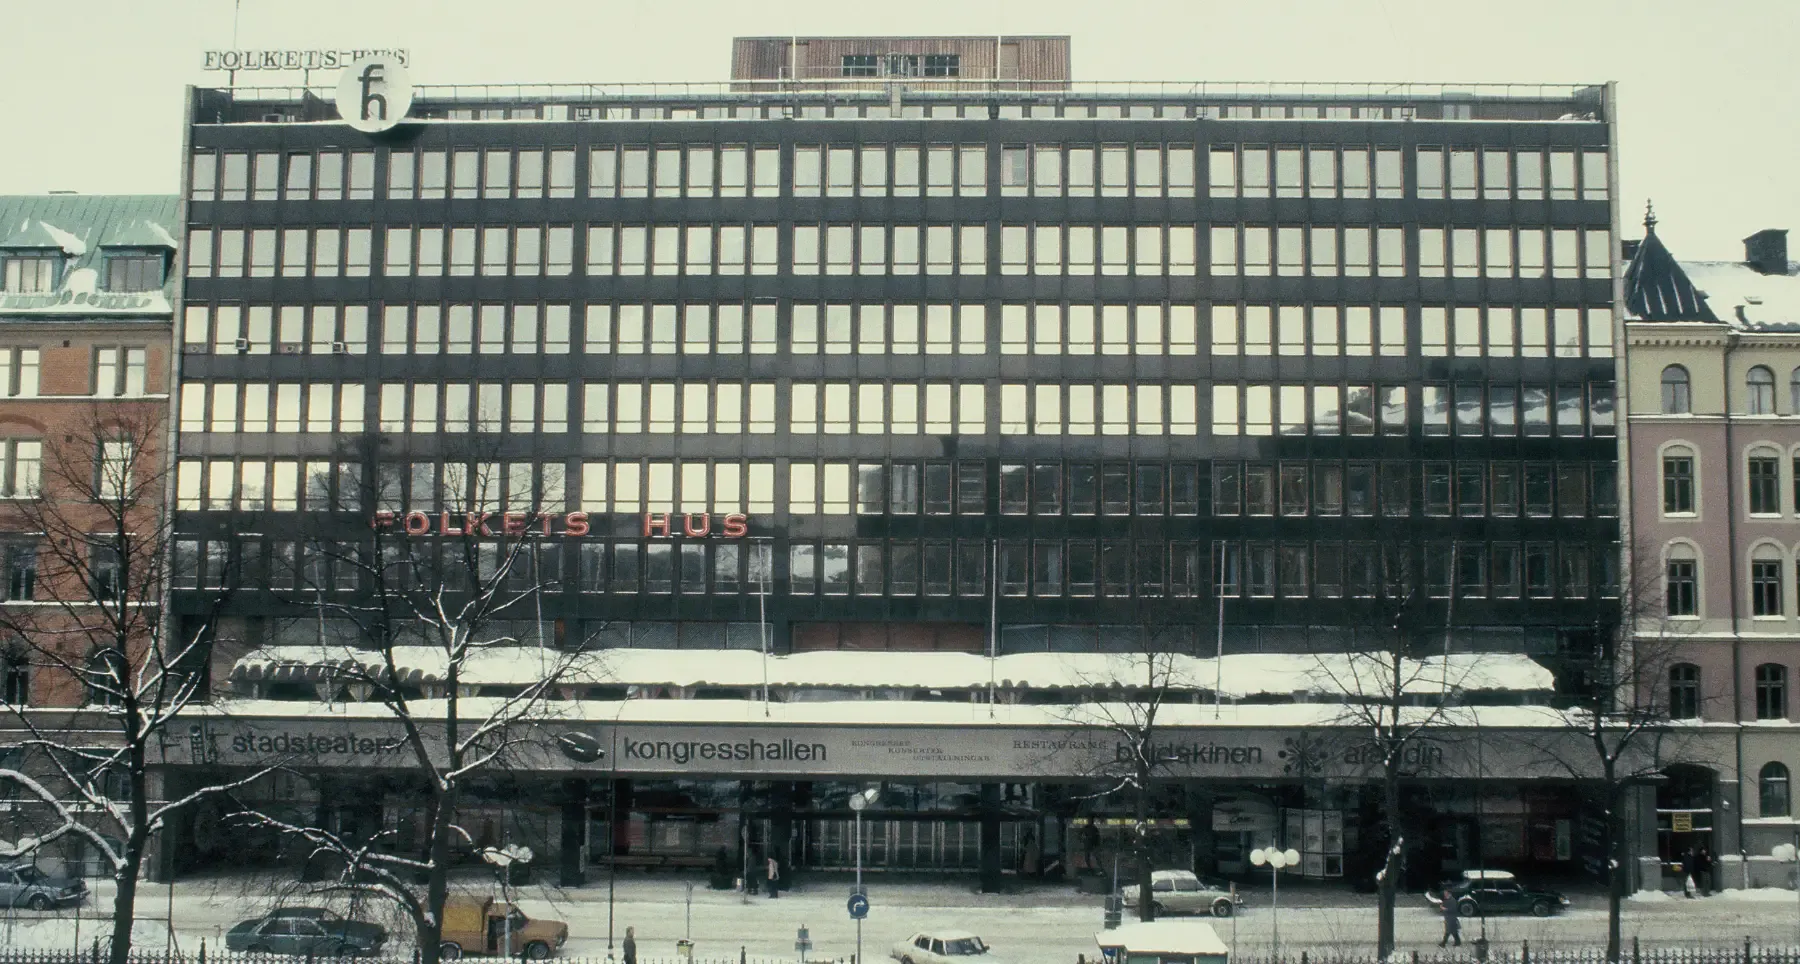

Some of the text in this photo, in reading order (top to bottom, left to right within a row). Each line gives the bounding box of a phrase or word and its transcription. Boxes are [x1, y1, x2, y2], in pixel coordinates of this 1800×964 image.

[204, 50, 338, 67] FOLKETS
[371, 510, 748, 538] FOLKETS HUS
[231, 731, 402, 755] stadsteatern
[623, 737, 827, 764] kongresshallen
[1012, 740, 1263, 765] RESTAURANG bldakinen
